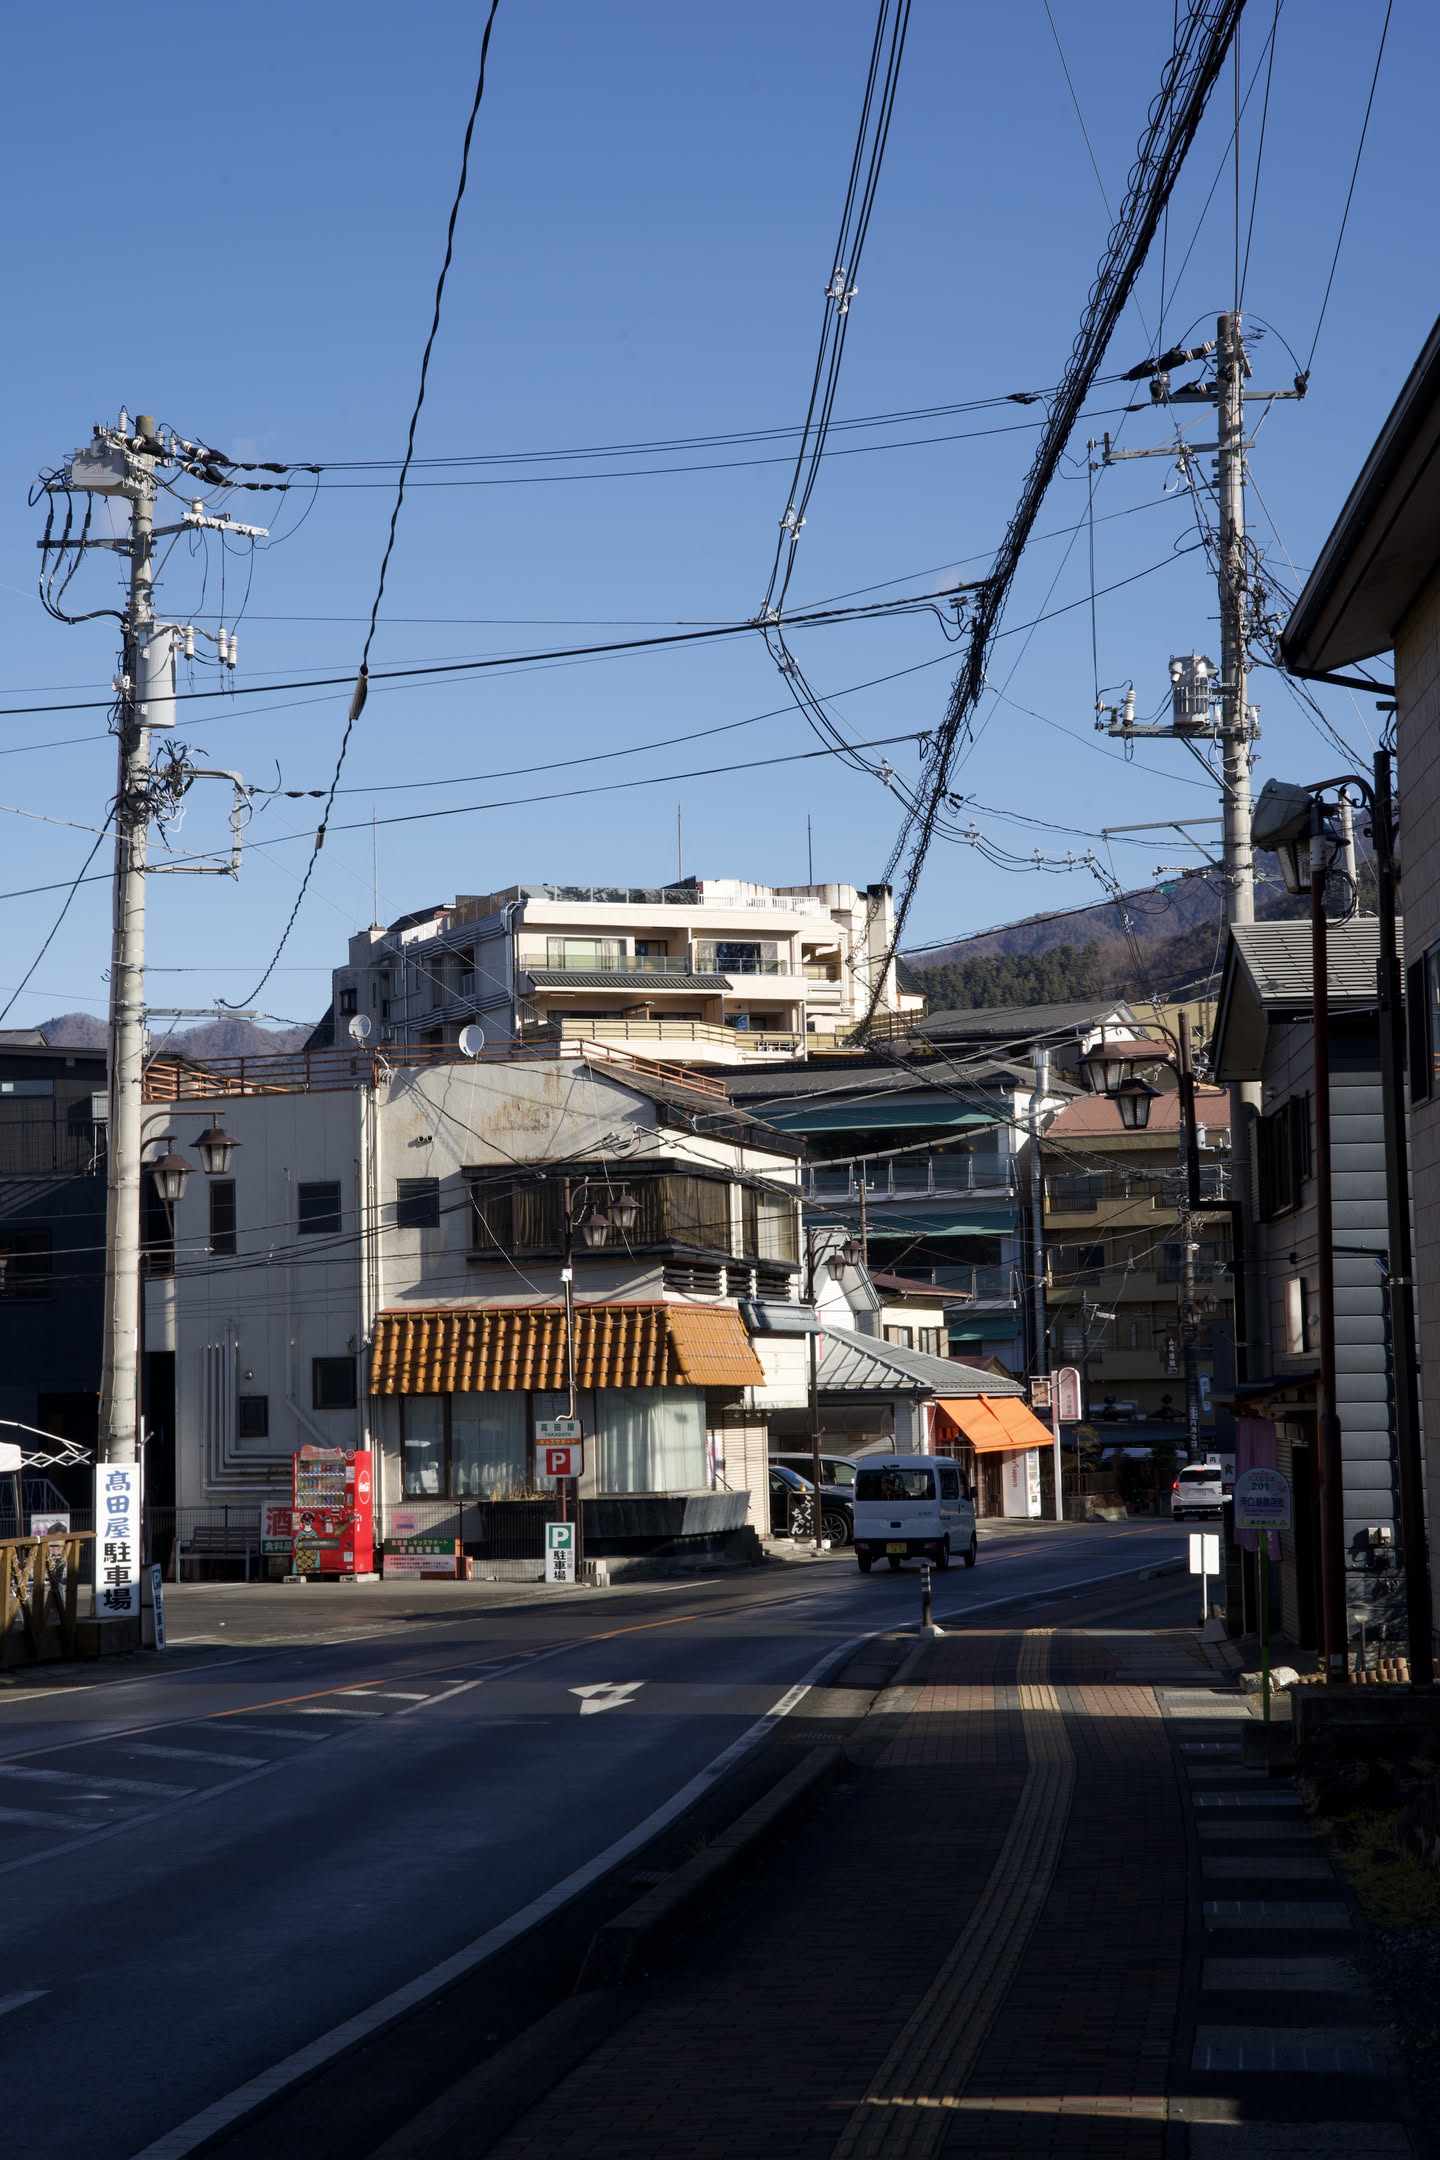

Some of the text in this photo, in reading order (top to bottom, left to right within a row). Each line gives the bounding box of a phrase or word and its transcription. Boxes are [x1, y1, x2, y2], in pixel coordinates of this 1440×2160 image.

[552, 1452, 566, 1472] P
[1251, 1482, 1270, 1490] 201
[265, 1506, 293, 1537] 酒
[552, 1527, 569, 1548] P
[553, 1550, 567, 1581] 駐車場
